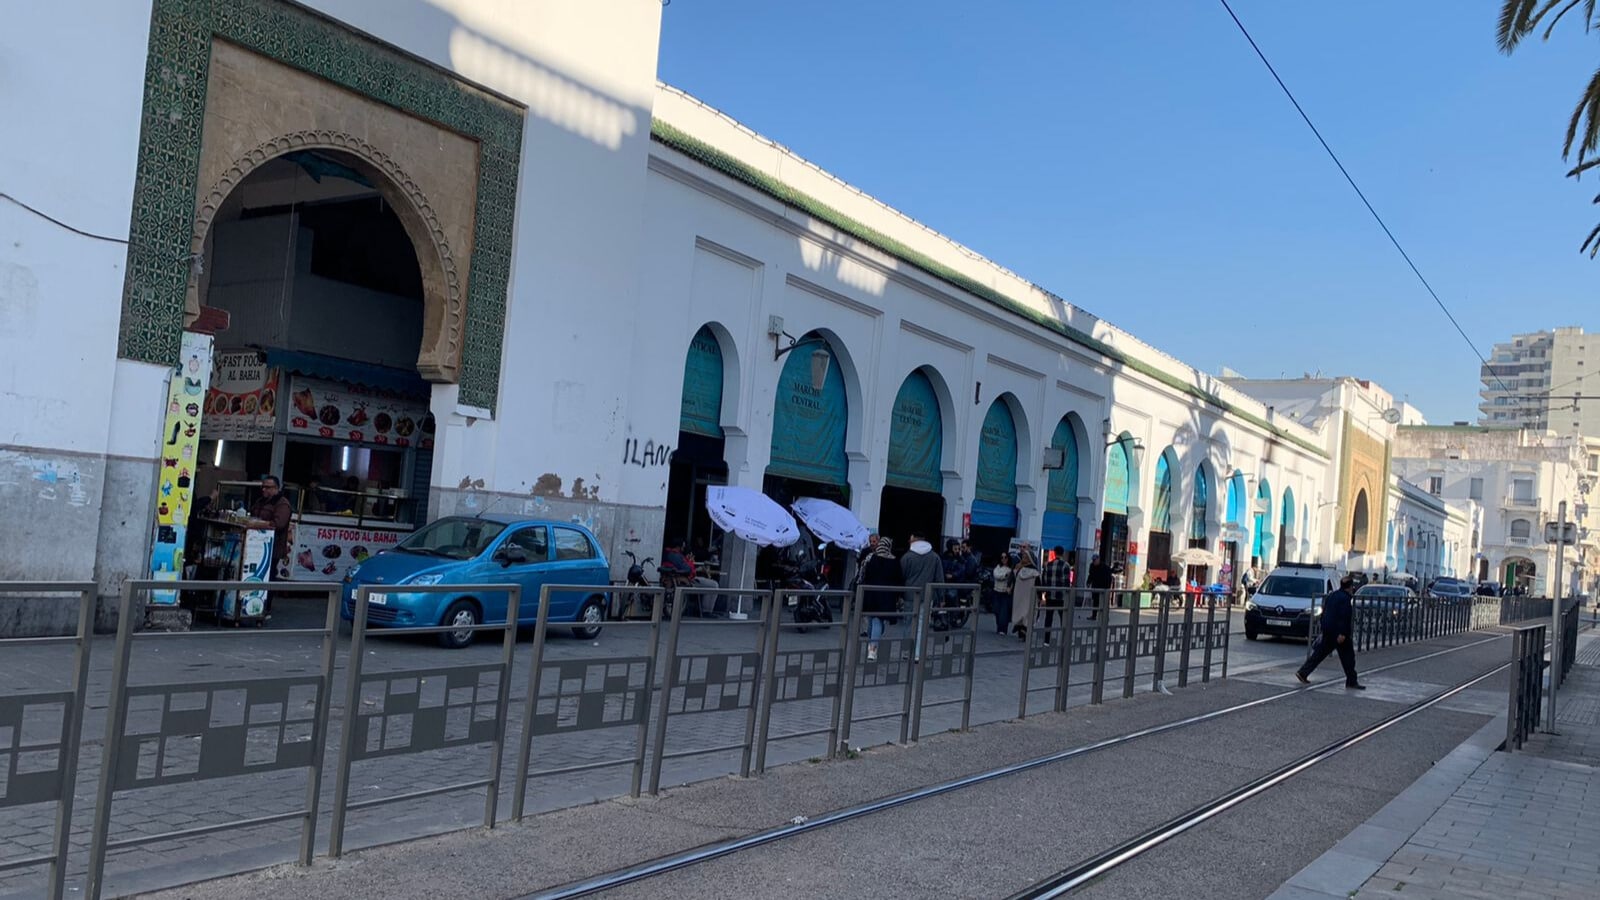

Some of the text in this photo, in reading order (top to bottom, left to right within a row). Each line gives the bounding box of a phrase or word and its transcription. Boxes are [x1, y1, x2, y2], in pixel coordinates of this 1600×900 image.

[223, 355, 242, 367] FAST
[228, 370, 261, 381] AL BAHJA
[791, 395, 821, 410] CENTRAL
[317, 528, 398, 543] FAST FOOD AL BAHJA
